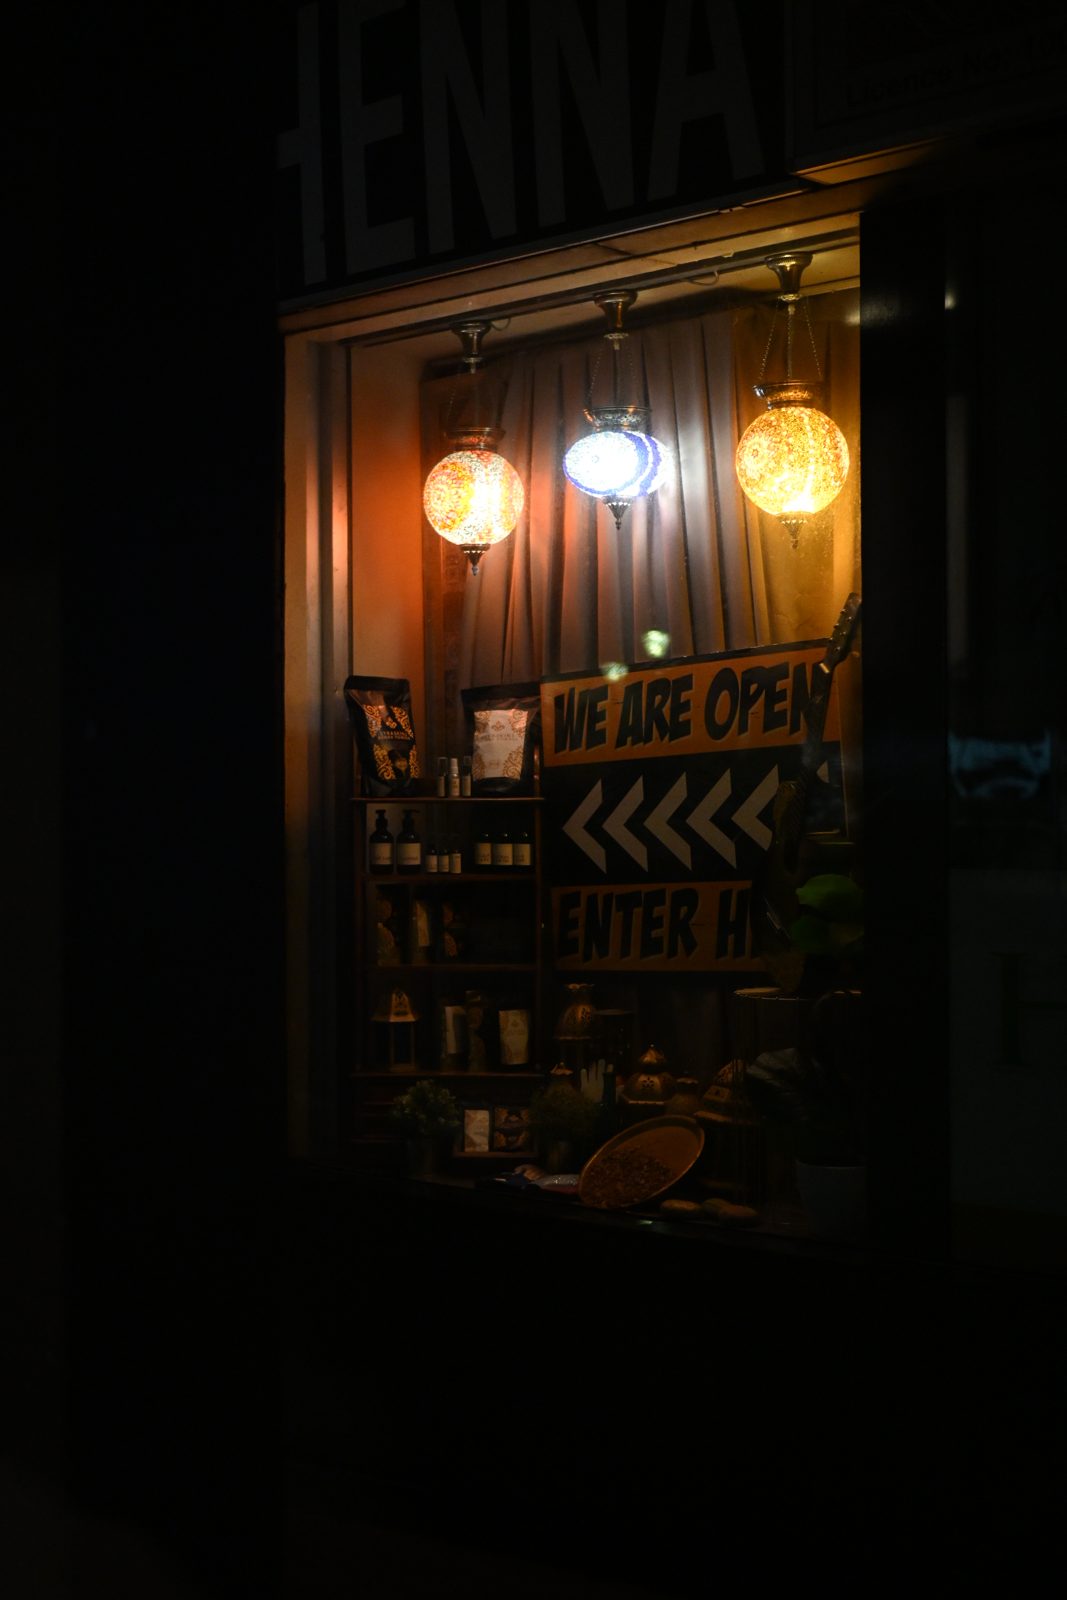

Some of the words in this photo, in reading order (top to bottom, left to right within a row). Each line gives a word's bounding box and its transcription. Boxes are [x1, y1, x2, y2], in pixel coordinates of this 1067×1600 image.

[553, 682, 610, 754] WE
[614, 672, 694, 750] ARE
[704, 661, 828, 741] OPEN
[557, 885, 700, 963] ENTER
